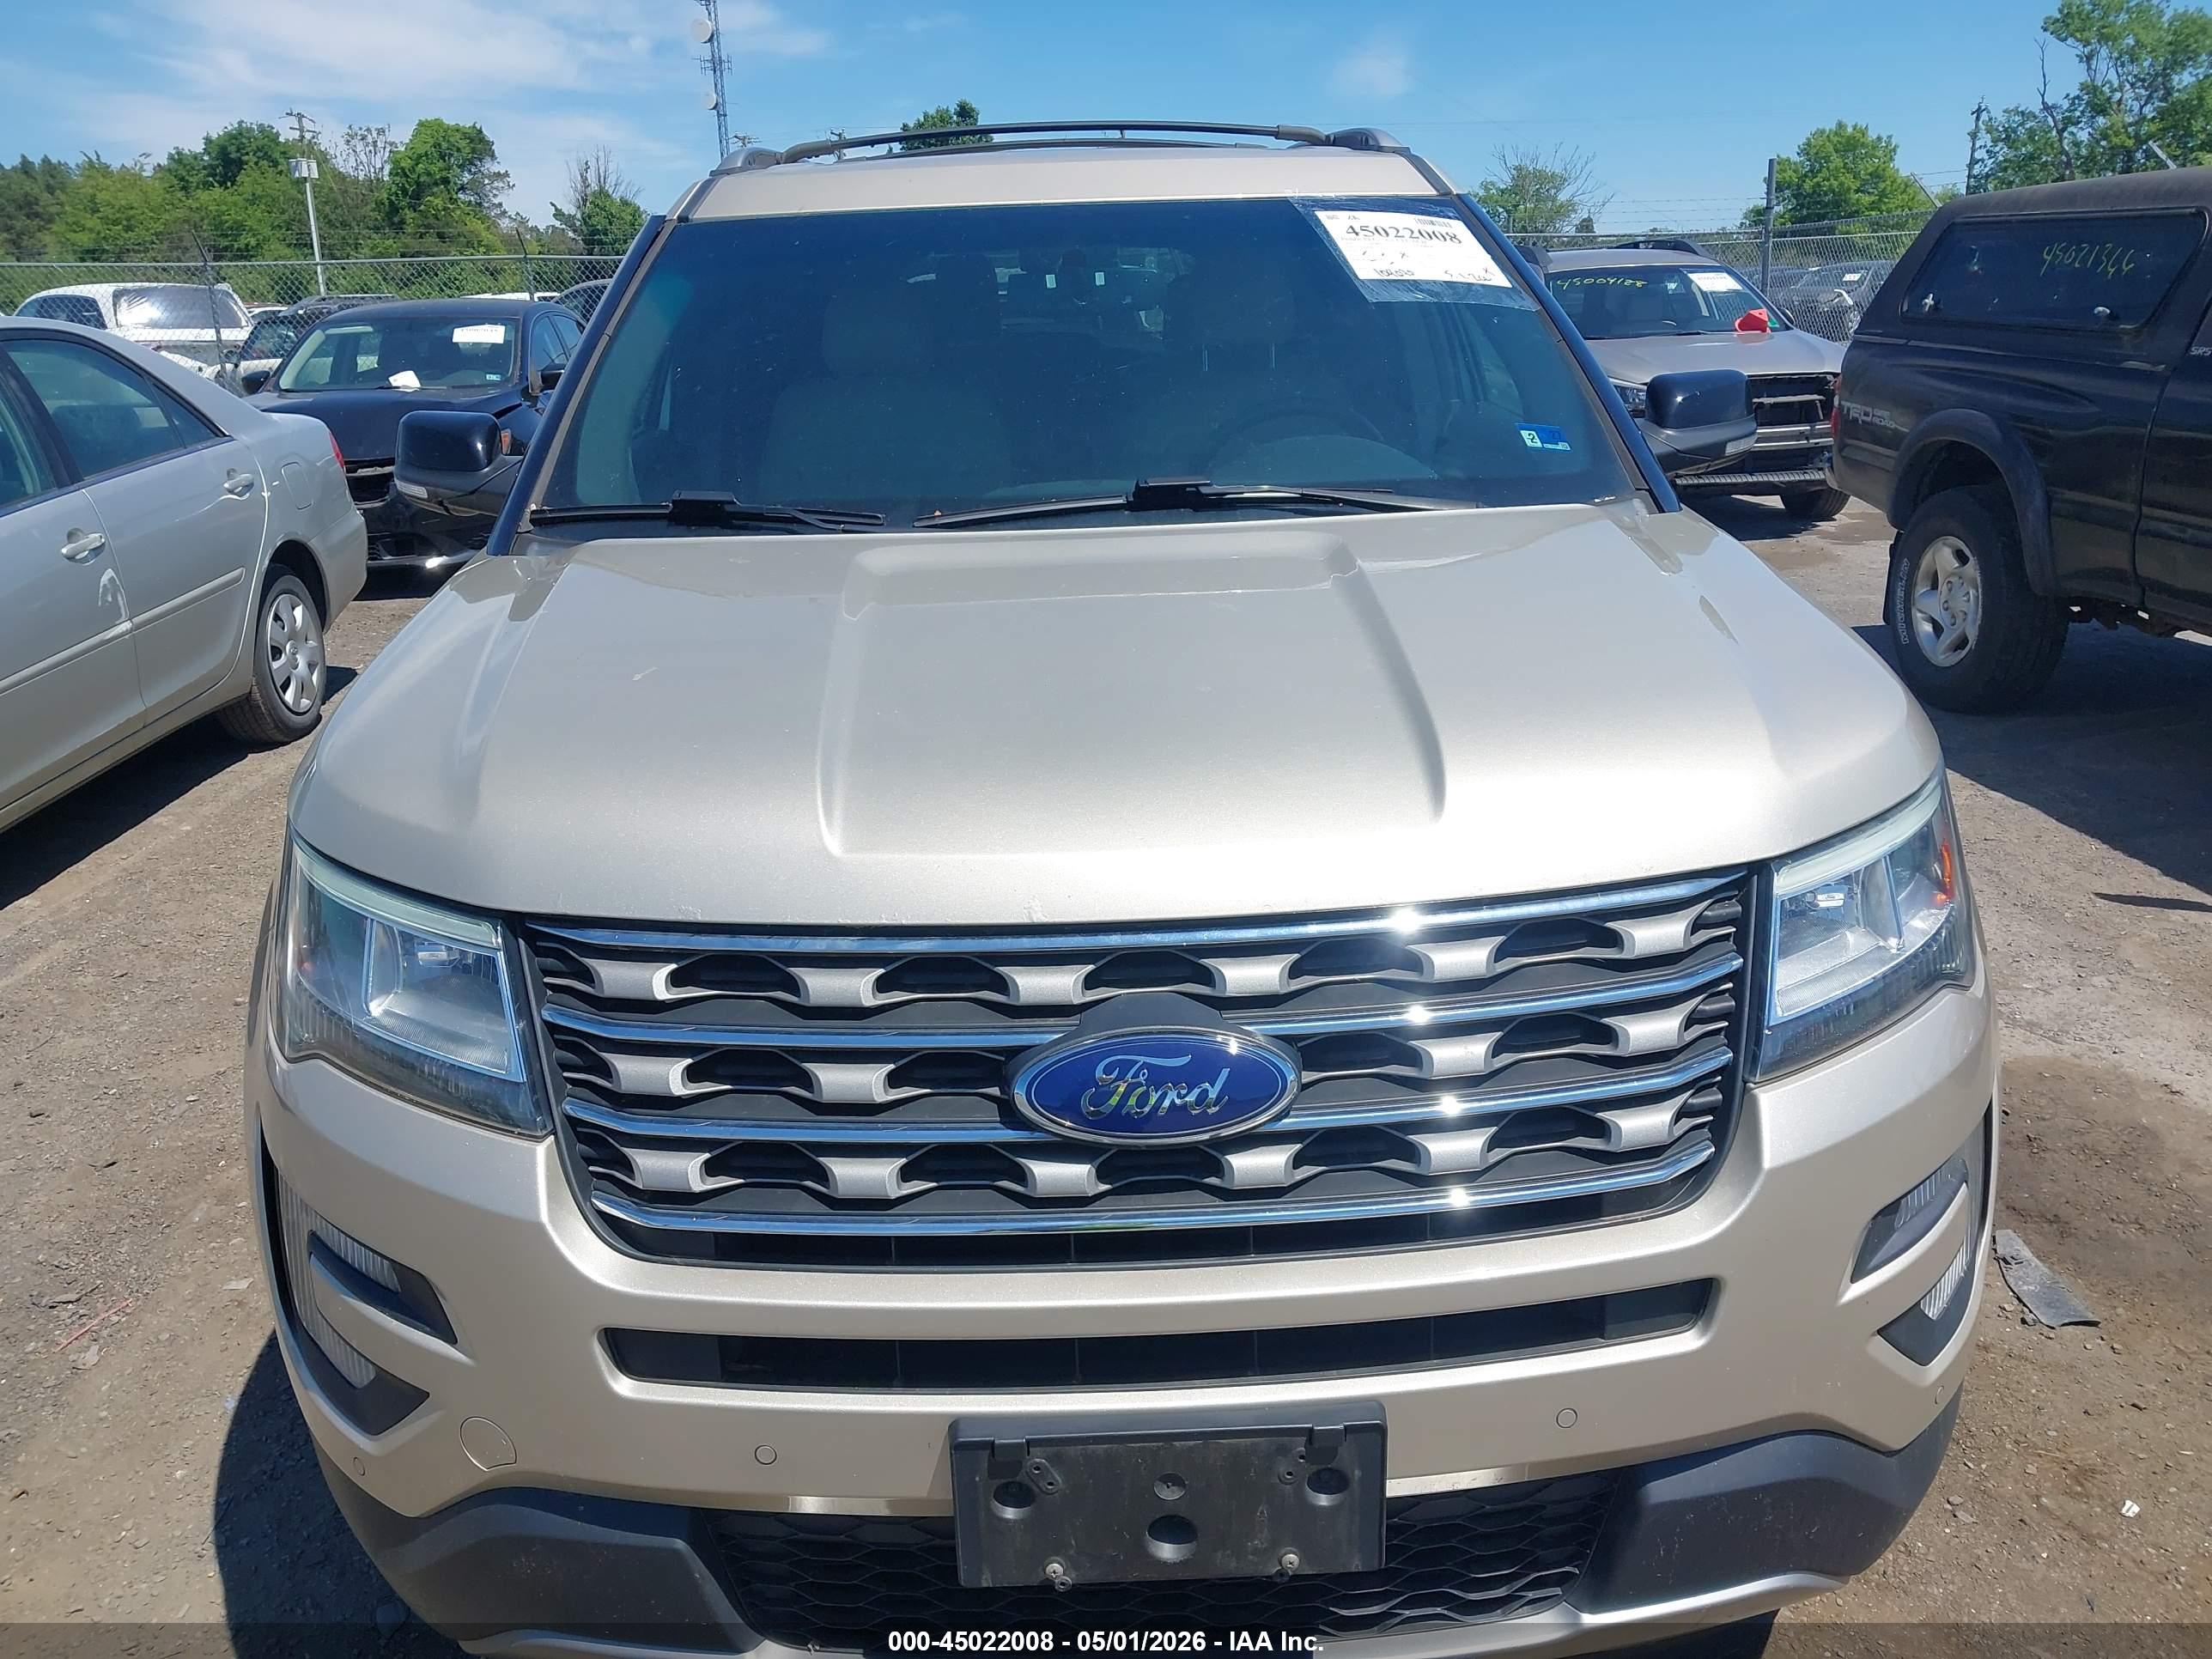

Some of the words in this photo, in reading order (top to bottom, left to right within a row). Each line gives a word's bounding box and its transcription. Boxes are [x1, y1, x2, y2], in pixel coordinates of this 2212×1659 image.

[1346, 225, 1462, 245] 45022008
[1840, 400, 1873, 424] TRD
[1080, 1054, 1231, 1120] Ford
